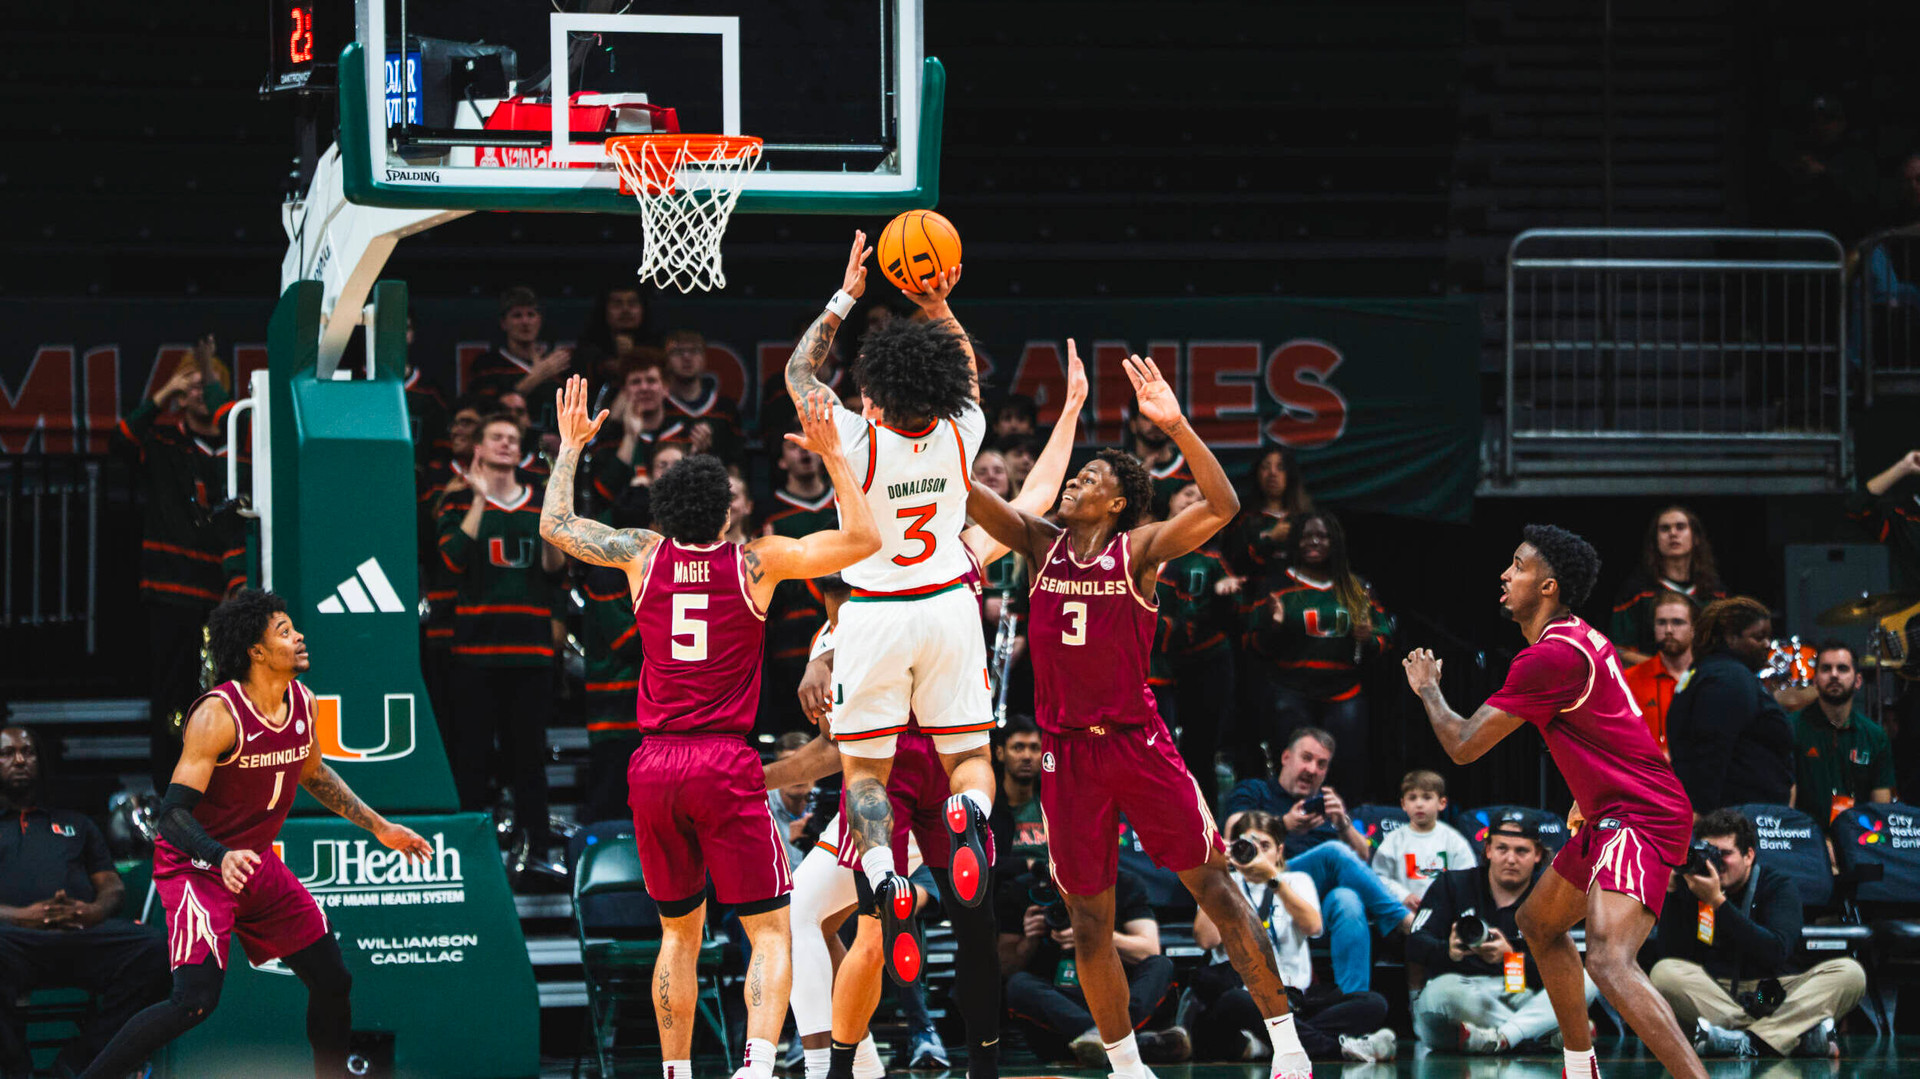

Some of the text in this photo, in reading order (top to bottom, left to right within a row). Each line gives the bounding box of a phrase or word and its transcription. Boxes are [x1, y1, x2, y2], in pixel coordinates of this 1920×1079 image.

[385, 169, 440, 183] SPALDING
[887, 478, 947, 499] DONALDSON
[891, 502, 937, 567] 3
[671, 593, 709, 661] 5
[1061, 601, 1088, 646] 3
[314, 692, 416, 762] U
[238, 744, 311, 769] SEMINOLES
[266, 771, 286, 811] 1
[1756, 815, 1782, 830] City
[1888, 814, 1913, 829] City
[1757, 828, 1812, 839] National
[1759, 839, 1792, 850] Bank
[326, 893, 342, 907] OF
[343, 892, 379, 906] MIAMI
[381, 891, 422, 905] HEALTH
[422, 889, 465, 903] SYSTEM
[357, 935, 478, 950] WILLIAMSON
[371, 951, 464, 965] CADILLAC
